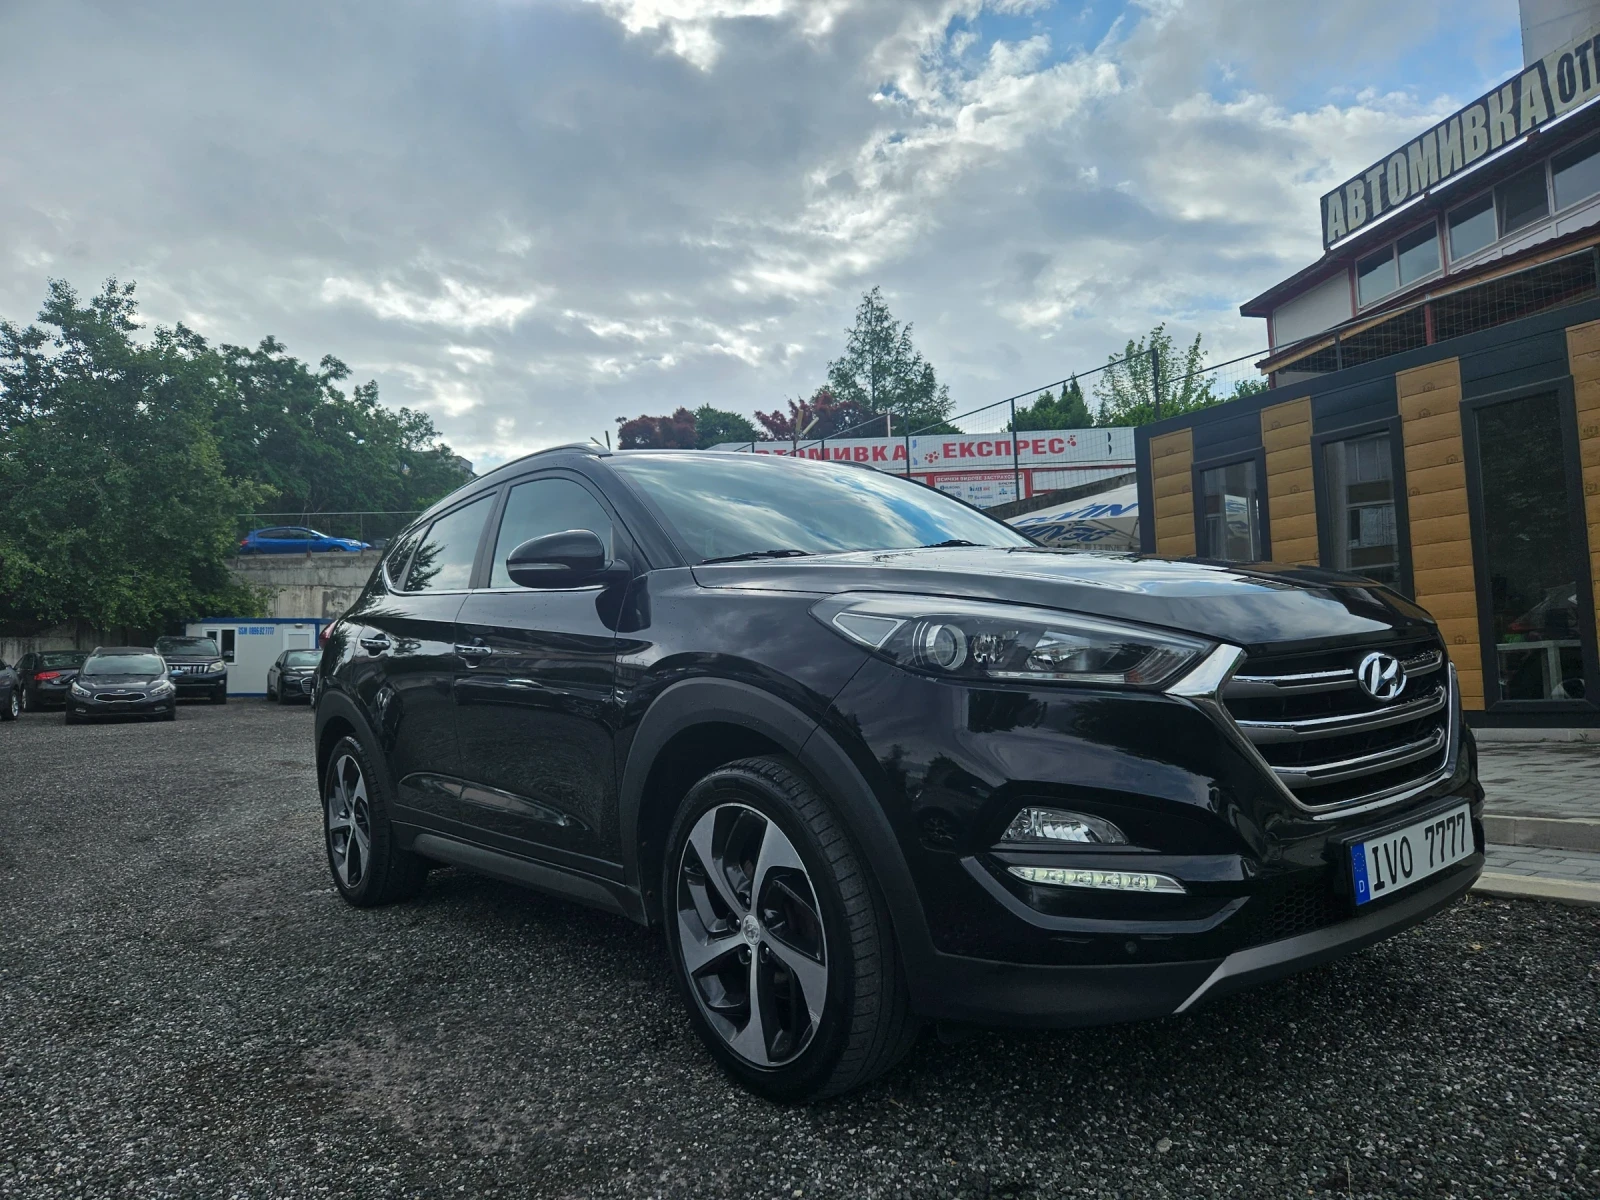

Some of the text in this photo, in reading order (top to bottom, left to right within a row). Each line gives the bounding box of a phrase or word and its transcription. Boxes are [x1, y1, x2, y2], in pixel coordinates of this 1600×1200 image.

[1326, 66, 1549, 244] АВТОМИВКА
[942, 438, 1065, 459] ЕКСПРЕС
[1372, 811, 1466, 892] IVO 7777
[1358, 879, 1365, 894] D
